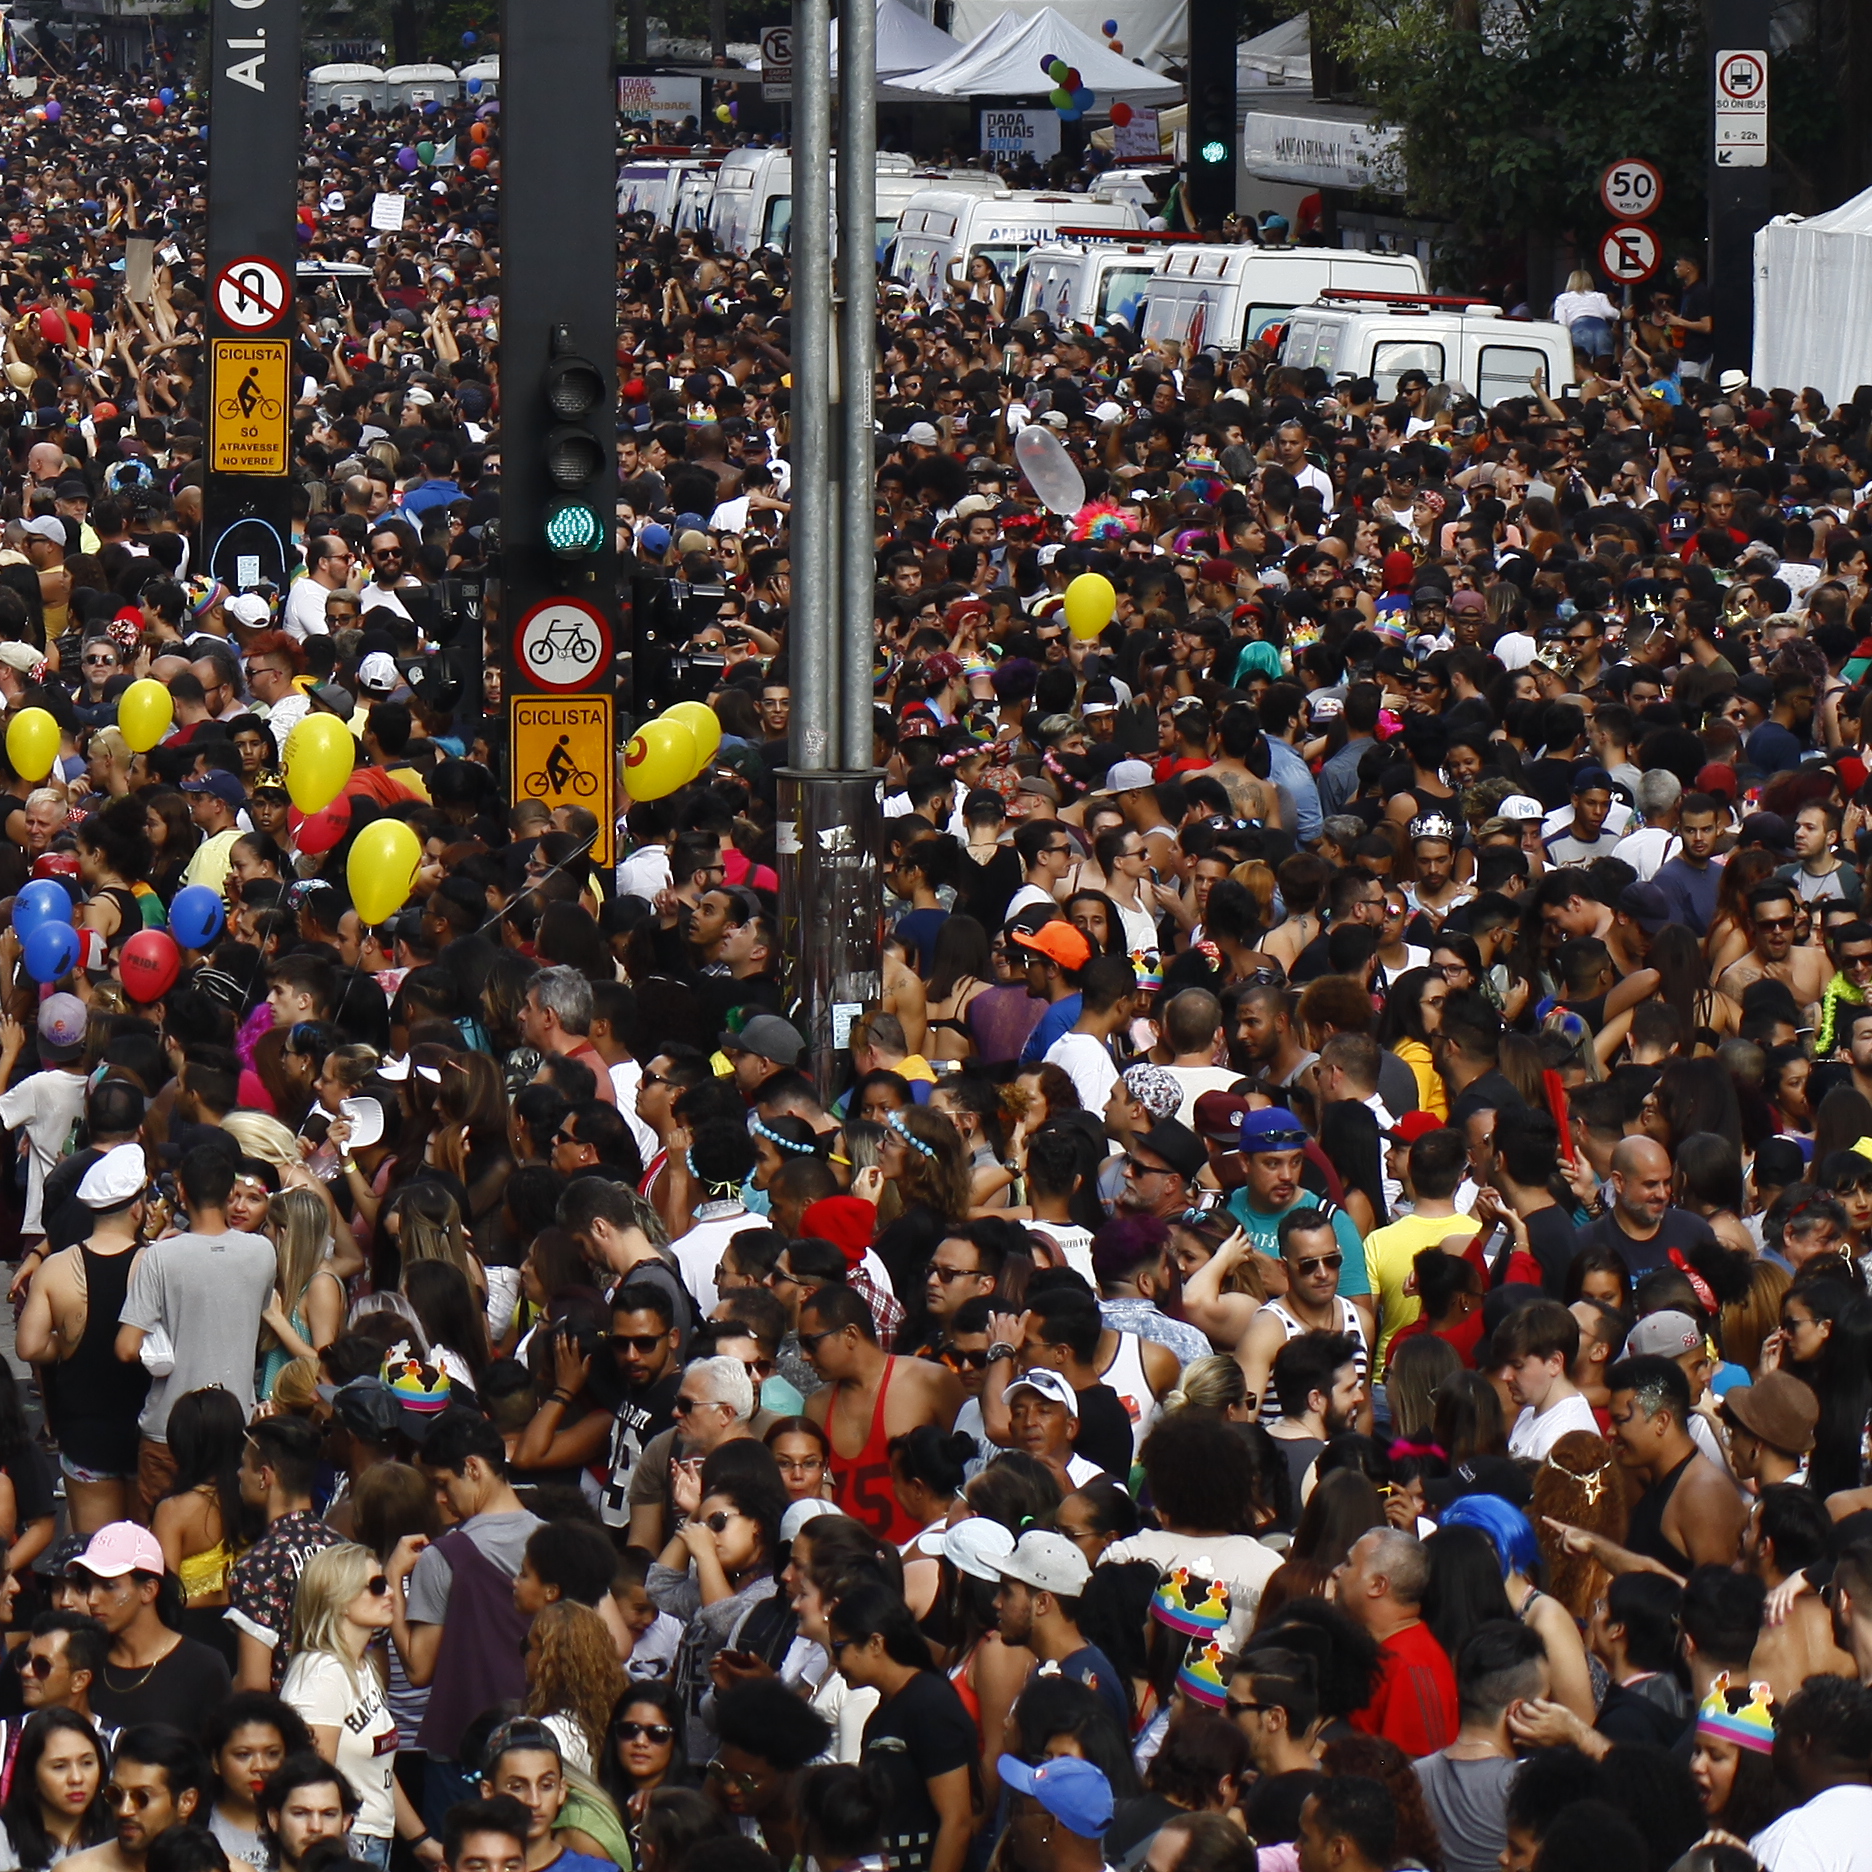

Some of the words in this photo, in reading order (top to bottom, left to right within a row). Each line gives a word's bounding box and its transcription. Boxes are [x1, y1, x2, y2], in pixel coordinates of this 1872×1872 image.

[225, 25, 267, 91] Al.
[622, 78, 652, 88] MAIS
[622, 95, 651, 104] MAIS
[1732, 97, 1767, 109] ÔNIBUS
[987, 113, 1025, 126] NADA
[987, 126, 995, 138] E
[996, 125, 1035, 139] MAIS
[989, 138, 1023, 149] BOLD
[1612, 171, 1652, 200] 50
[1618, 201, 1643, 212] km/h
[219, 348, 283, 361] CICLISTA
[240, 424, 259, 438] SÓ
[219, 443, 280, 453] ATRAVESSE
[223, 457, 239, 466] NO
[241, 457, 275, 466] VERDE
[518, 709, 604, 726] CICLISTA
